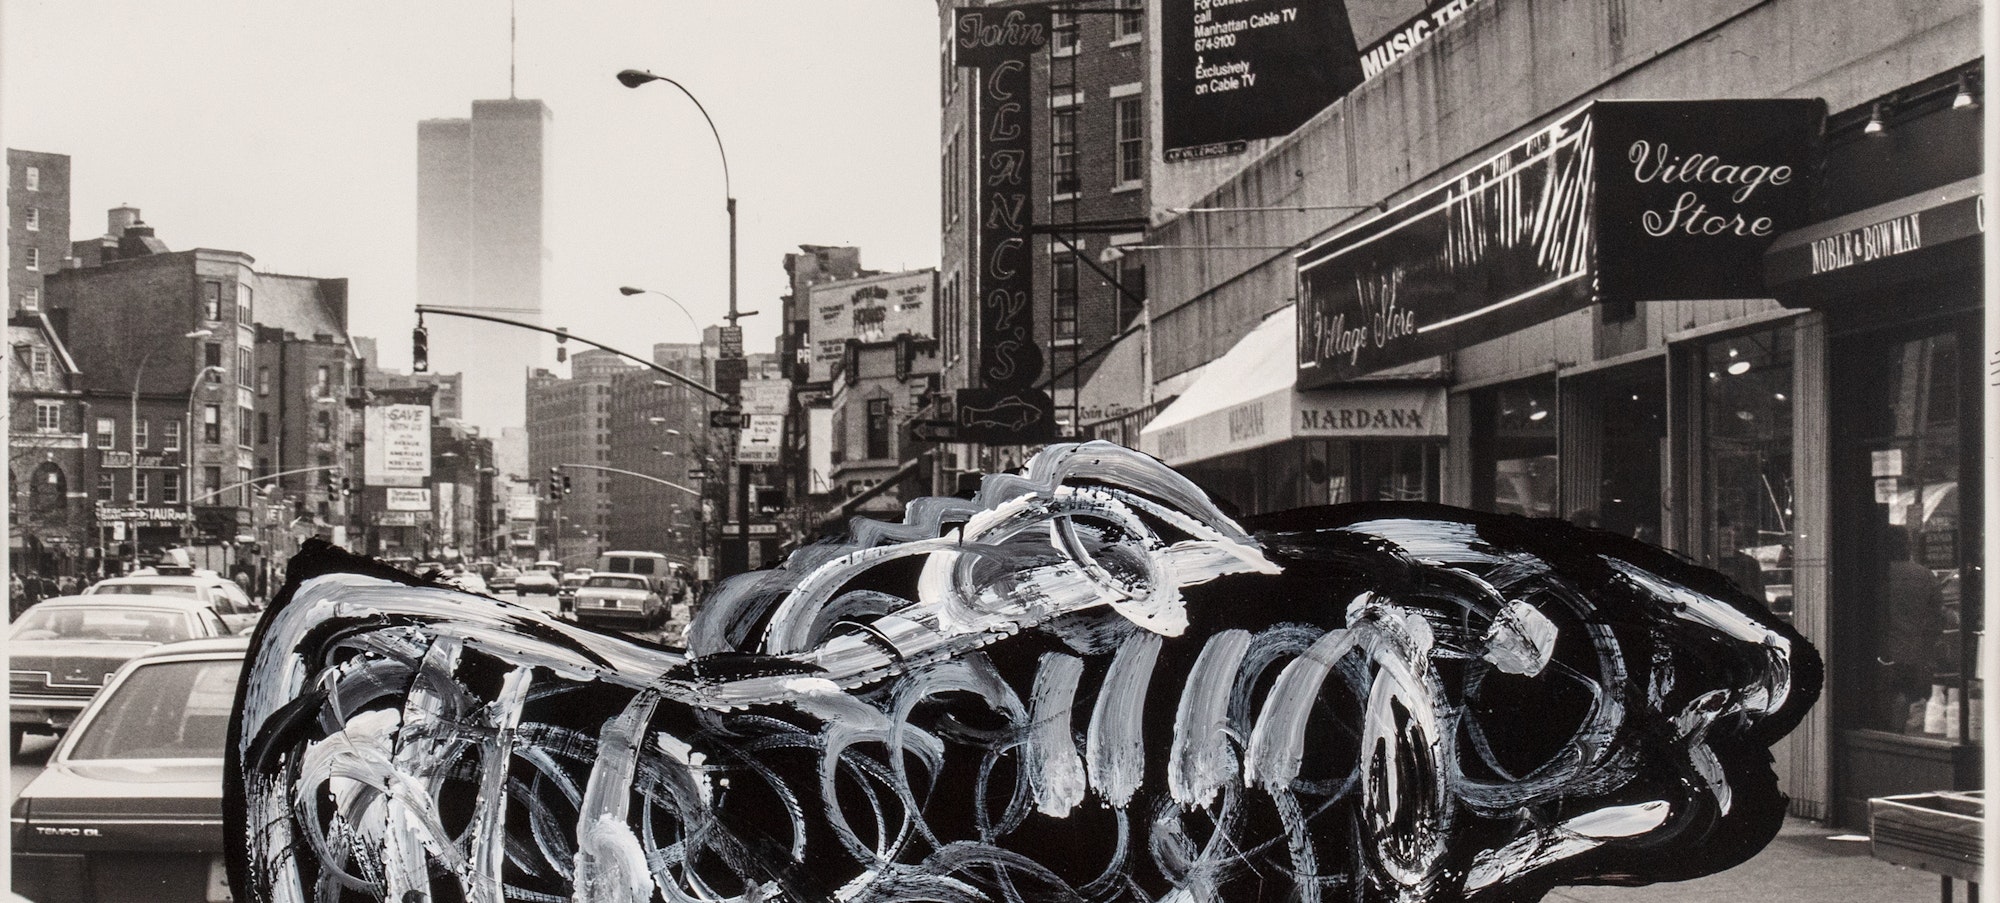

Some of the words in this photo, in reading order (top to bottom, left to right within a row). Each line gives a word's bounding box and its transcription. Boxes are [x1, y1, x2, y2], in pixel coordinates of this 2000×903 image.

[959, 10, 1045, 48] John
[1194, 10, 1212, 24] call
[1194, 19, 1248, 38] Manhattan
[1250, 12, 1280, 28] Cable
[1281, 8, 1297, 22] TV
[1194, 34, 1236, 52] 674-9100
[1360, 19, 1432, 80] MUSIC
[1195, 60, 1250, 79] Exclusively
[1195, 83, 1208, 95] on
[1210, 76, 1239, 92] Cable
[1241, 74, 1256, 87] TV
[1628, 140, 1792, 203] Village
[986, 60, 1026, 380] CLANCY'S
[1642, 191, 1773, 237] Store
[1811, 232, 1854, 274] NOBLE
[1863, 212, 1921, 262] BOWMAN
[1314, 310, 1368, 368] Village
[1374, 272, 1414, 348] Store
[387, 409, 424, 422] SAVE
[1301, 408, 1424, 430] MARDANA
[36, 827, 80, 836] TEMPO
[83, 828, 103, 837] GL
